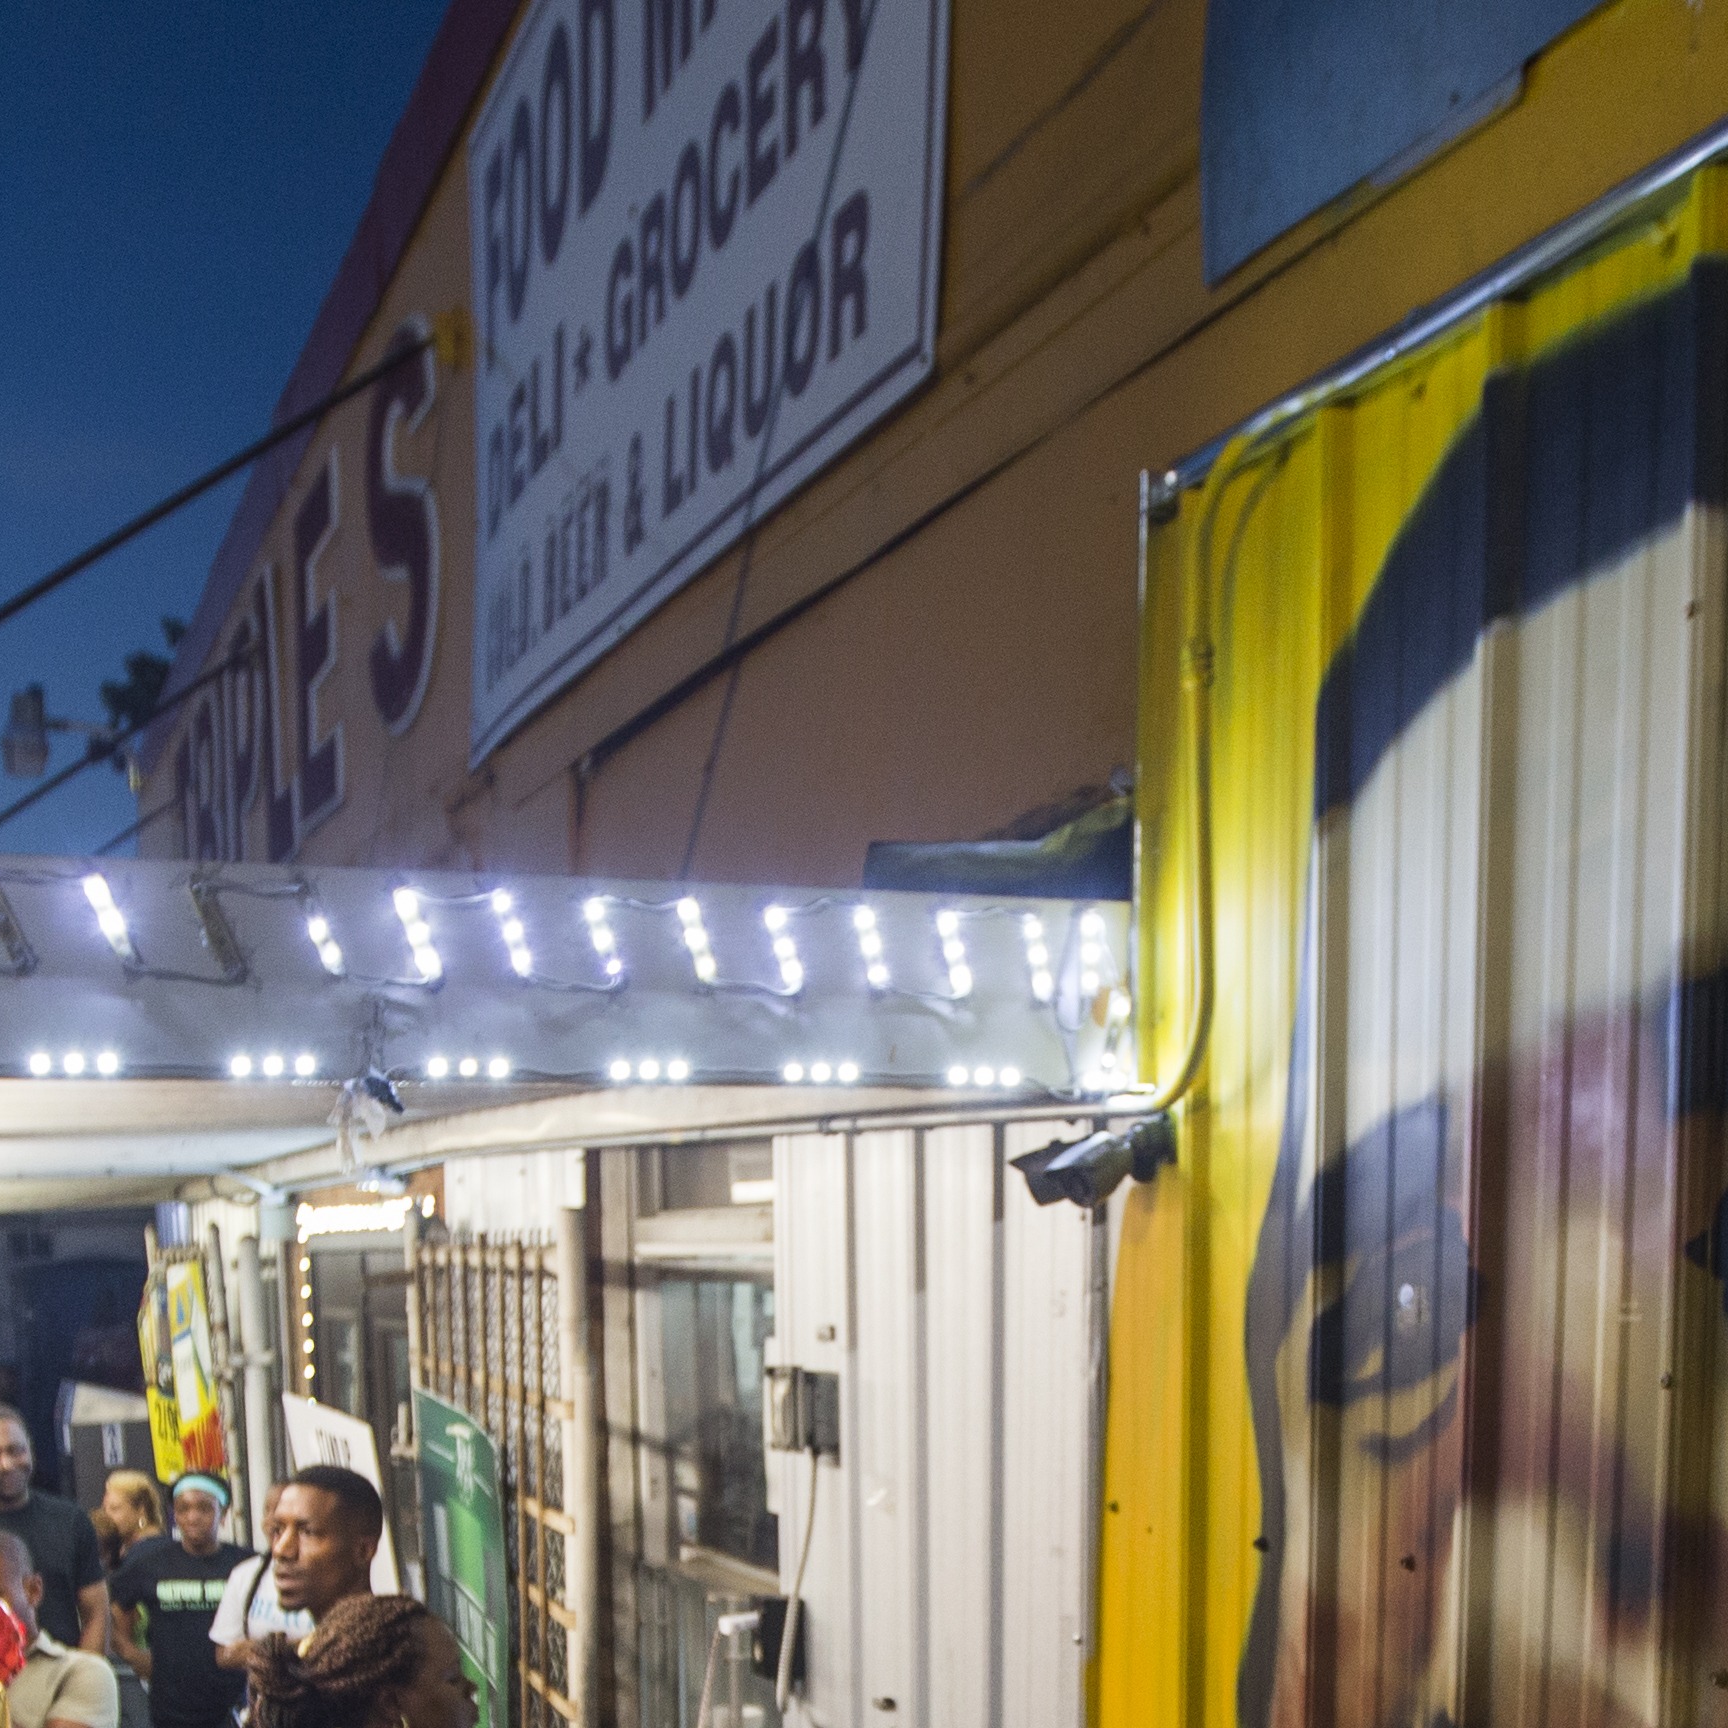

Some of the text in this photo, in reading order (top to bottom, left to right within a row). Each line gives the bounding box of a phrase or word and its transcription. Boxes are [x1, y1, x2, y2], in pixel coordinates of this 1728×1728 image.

[483, 0, 612, 370] FOOD
[487, 324, 566, 542] DELI
[623, 430, 646, 558] &
[663, 189, 871, 522] LIQUOR
[174, 314, 442, 867] TRIPLE S
